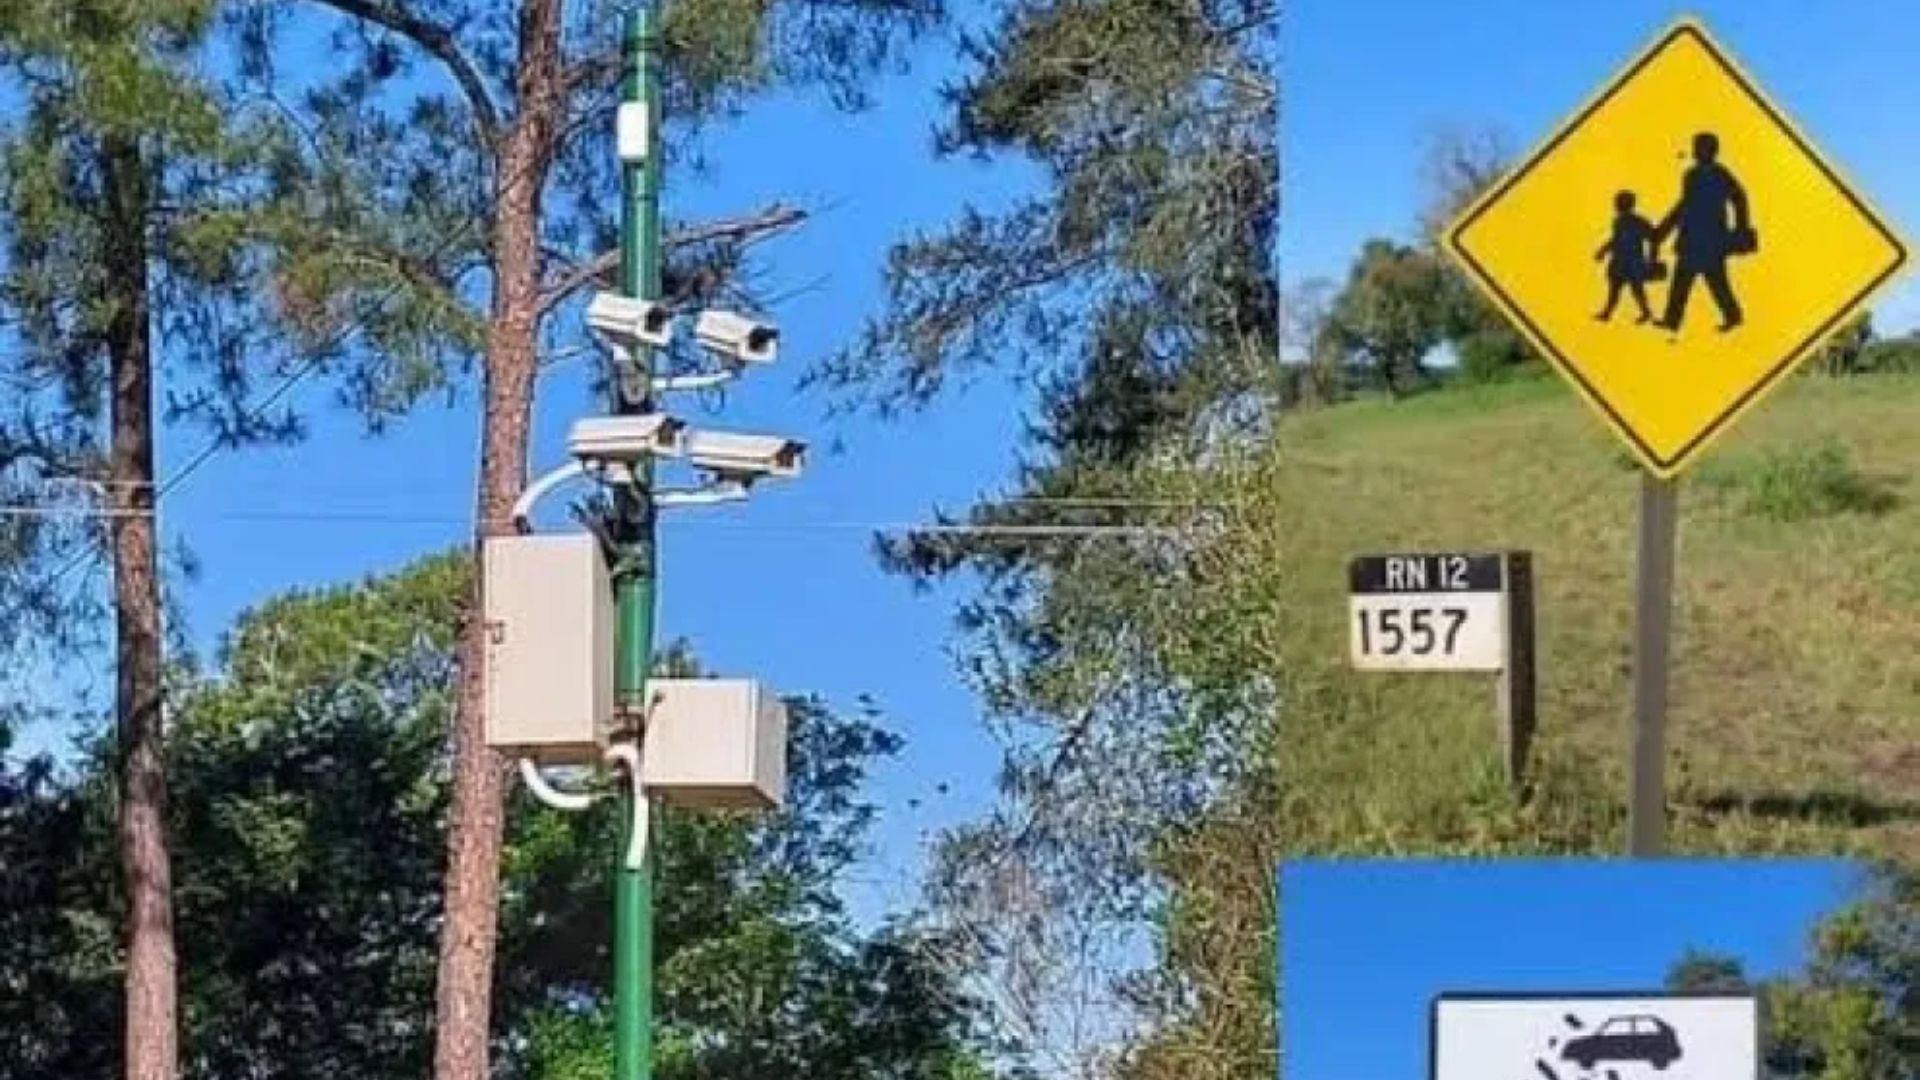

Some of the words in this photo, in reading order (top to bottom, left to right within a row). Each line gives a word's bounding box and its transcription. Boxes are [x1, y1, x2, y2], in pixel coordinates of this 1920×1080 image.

[1386, 557, 1426, 589] RN
[1440, 556, 1469, 589] 12
[1358, 608, 1468, 655] 1557
